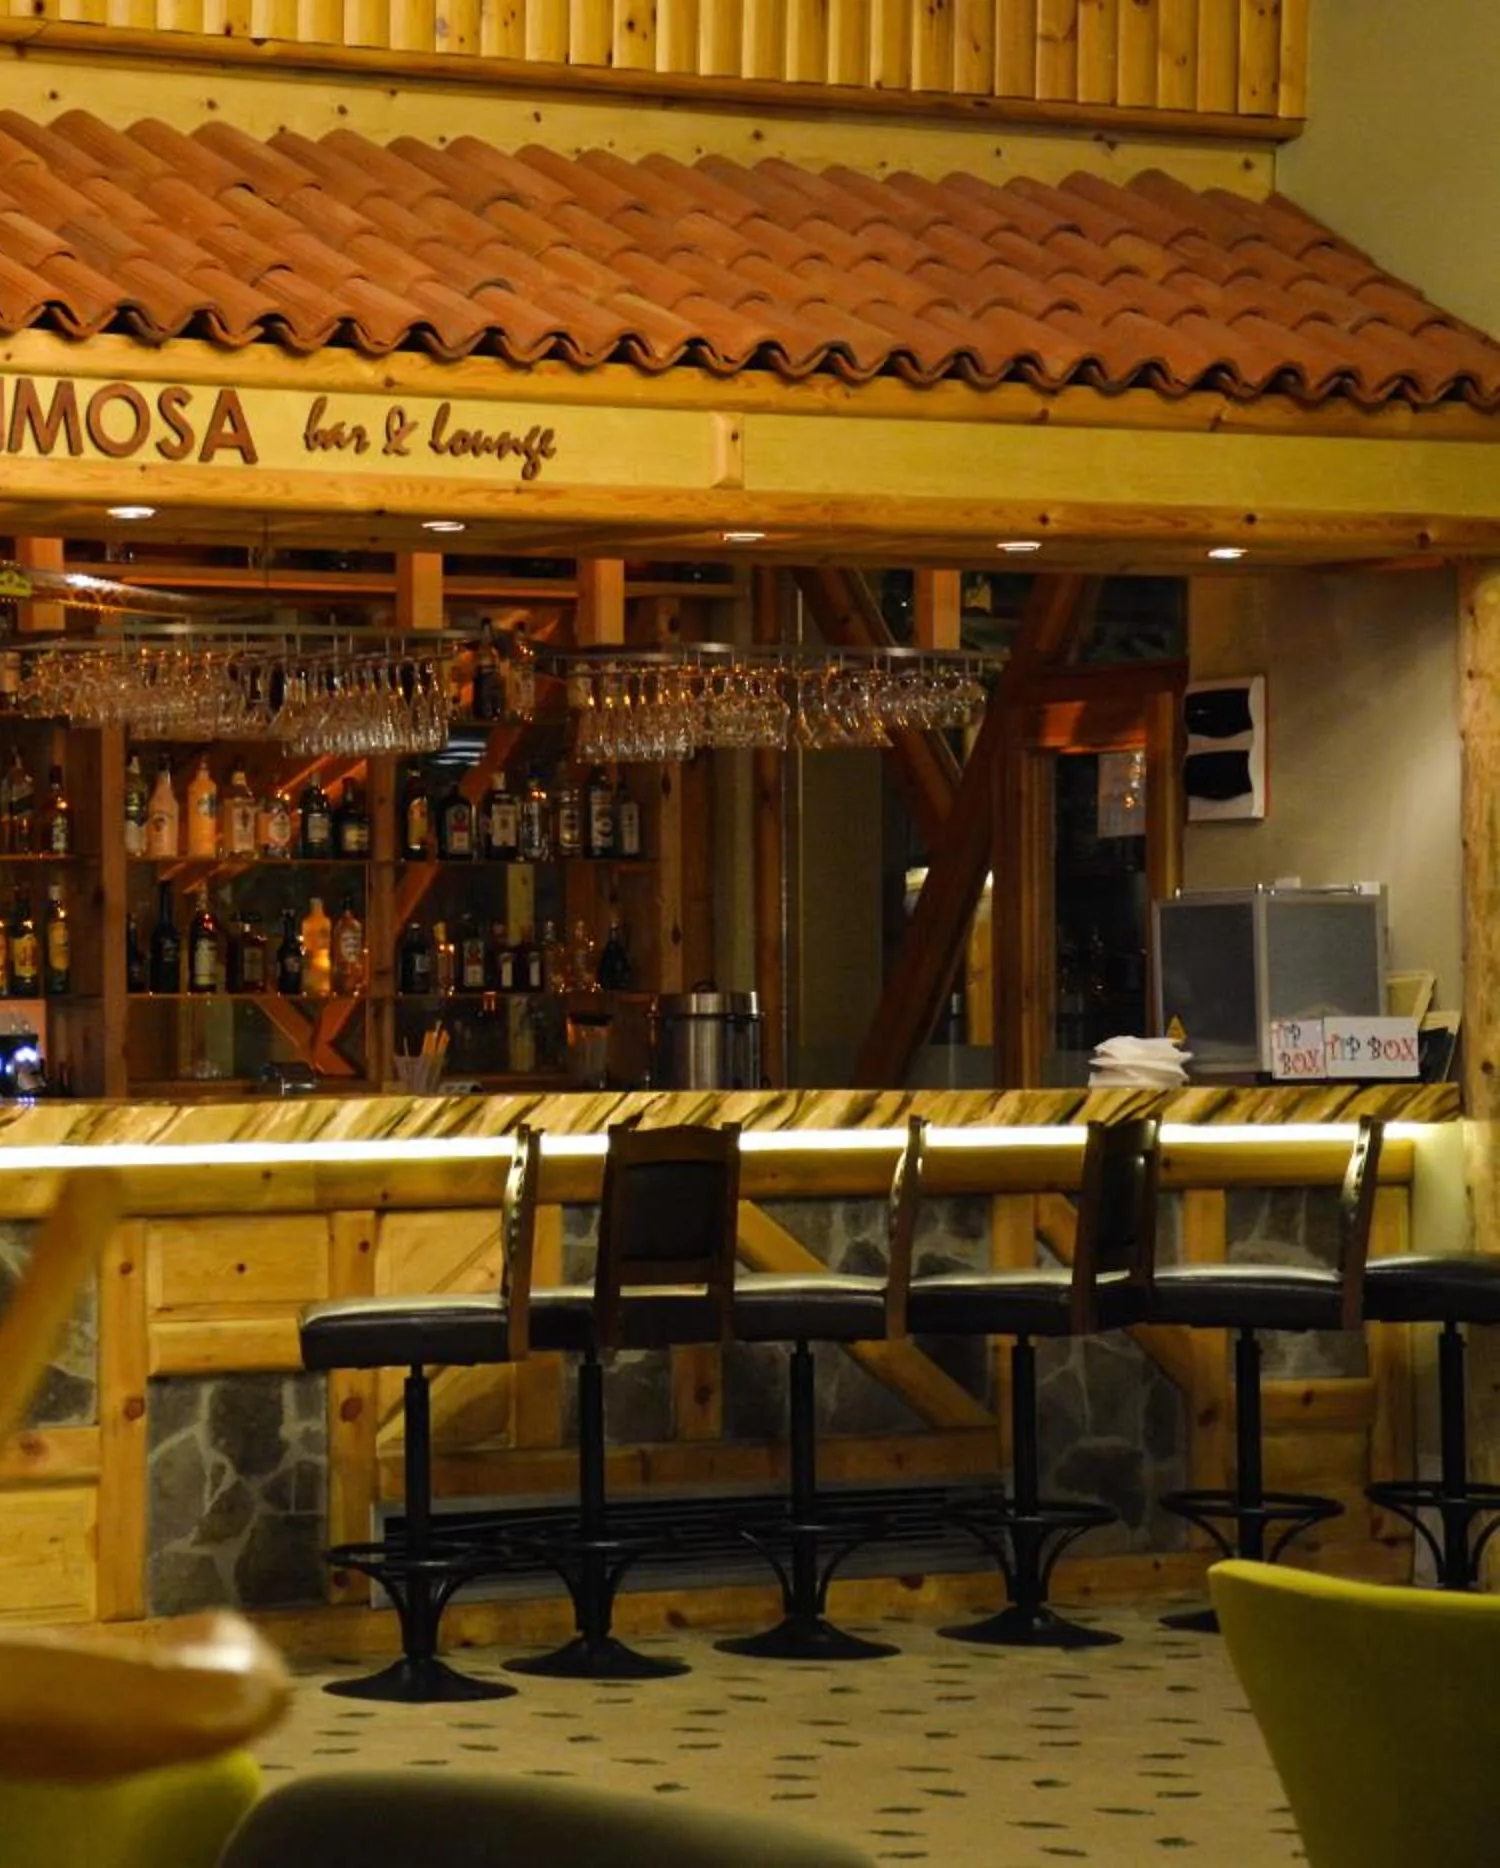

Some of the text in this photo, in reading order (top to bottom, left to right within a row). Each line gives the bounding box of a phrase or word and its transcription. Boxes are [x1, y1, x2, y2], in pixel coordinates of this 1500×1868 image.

[303, 395, 370, 455] bar
[383, 405, 417, 457] &
[428, 402, 557, 481] lounge
[1278, 1049, 1320, 1075] BOX
[1325, 1033, 1417, 1063] TIP BOX
